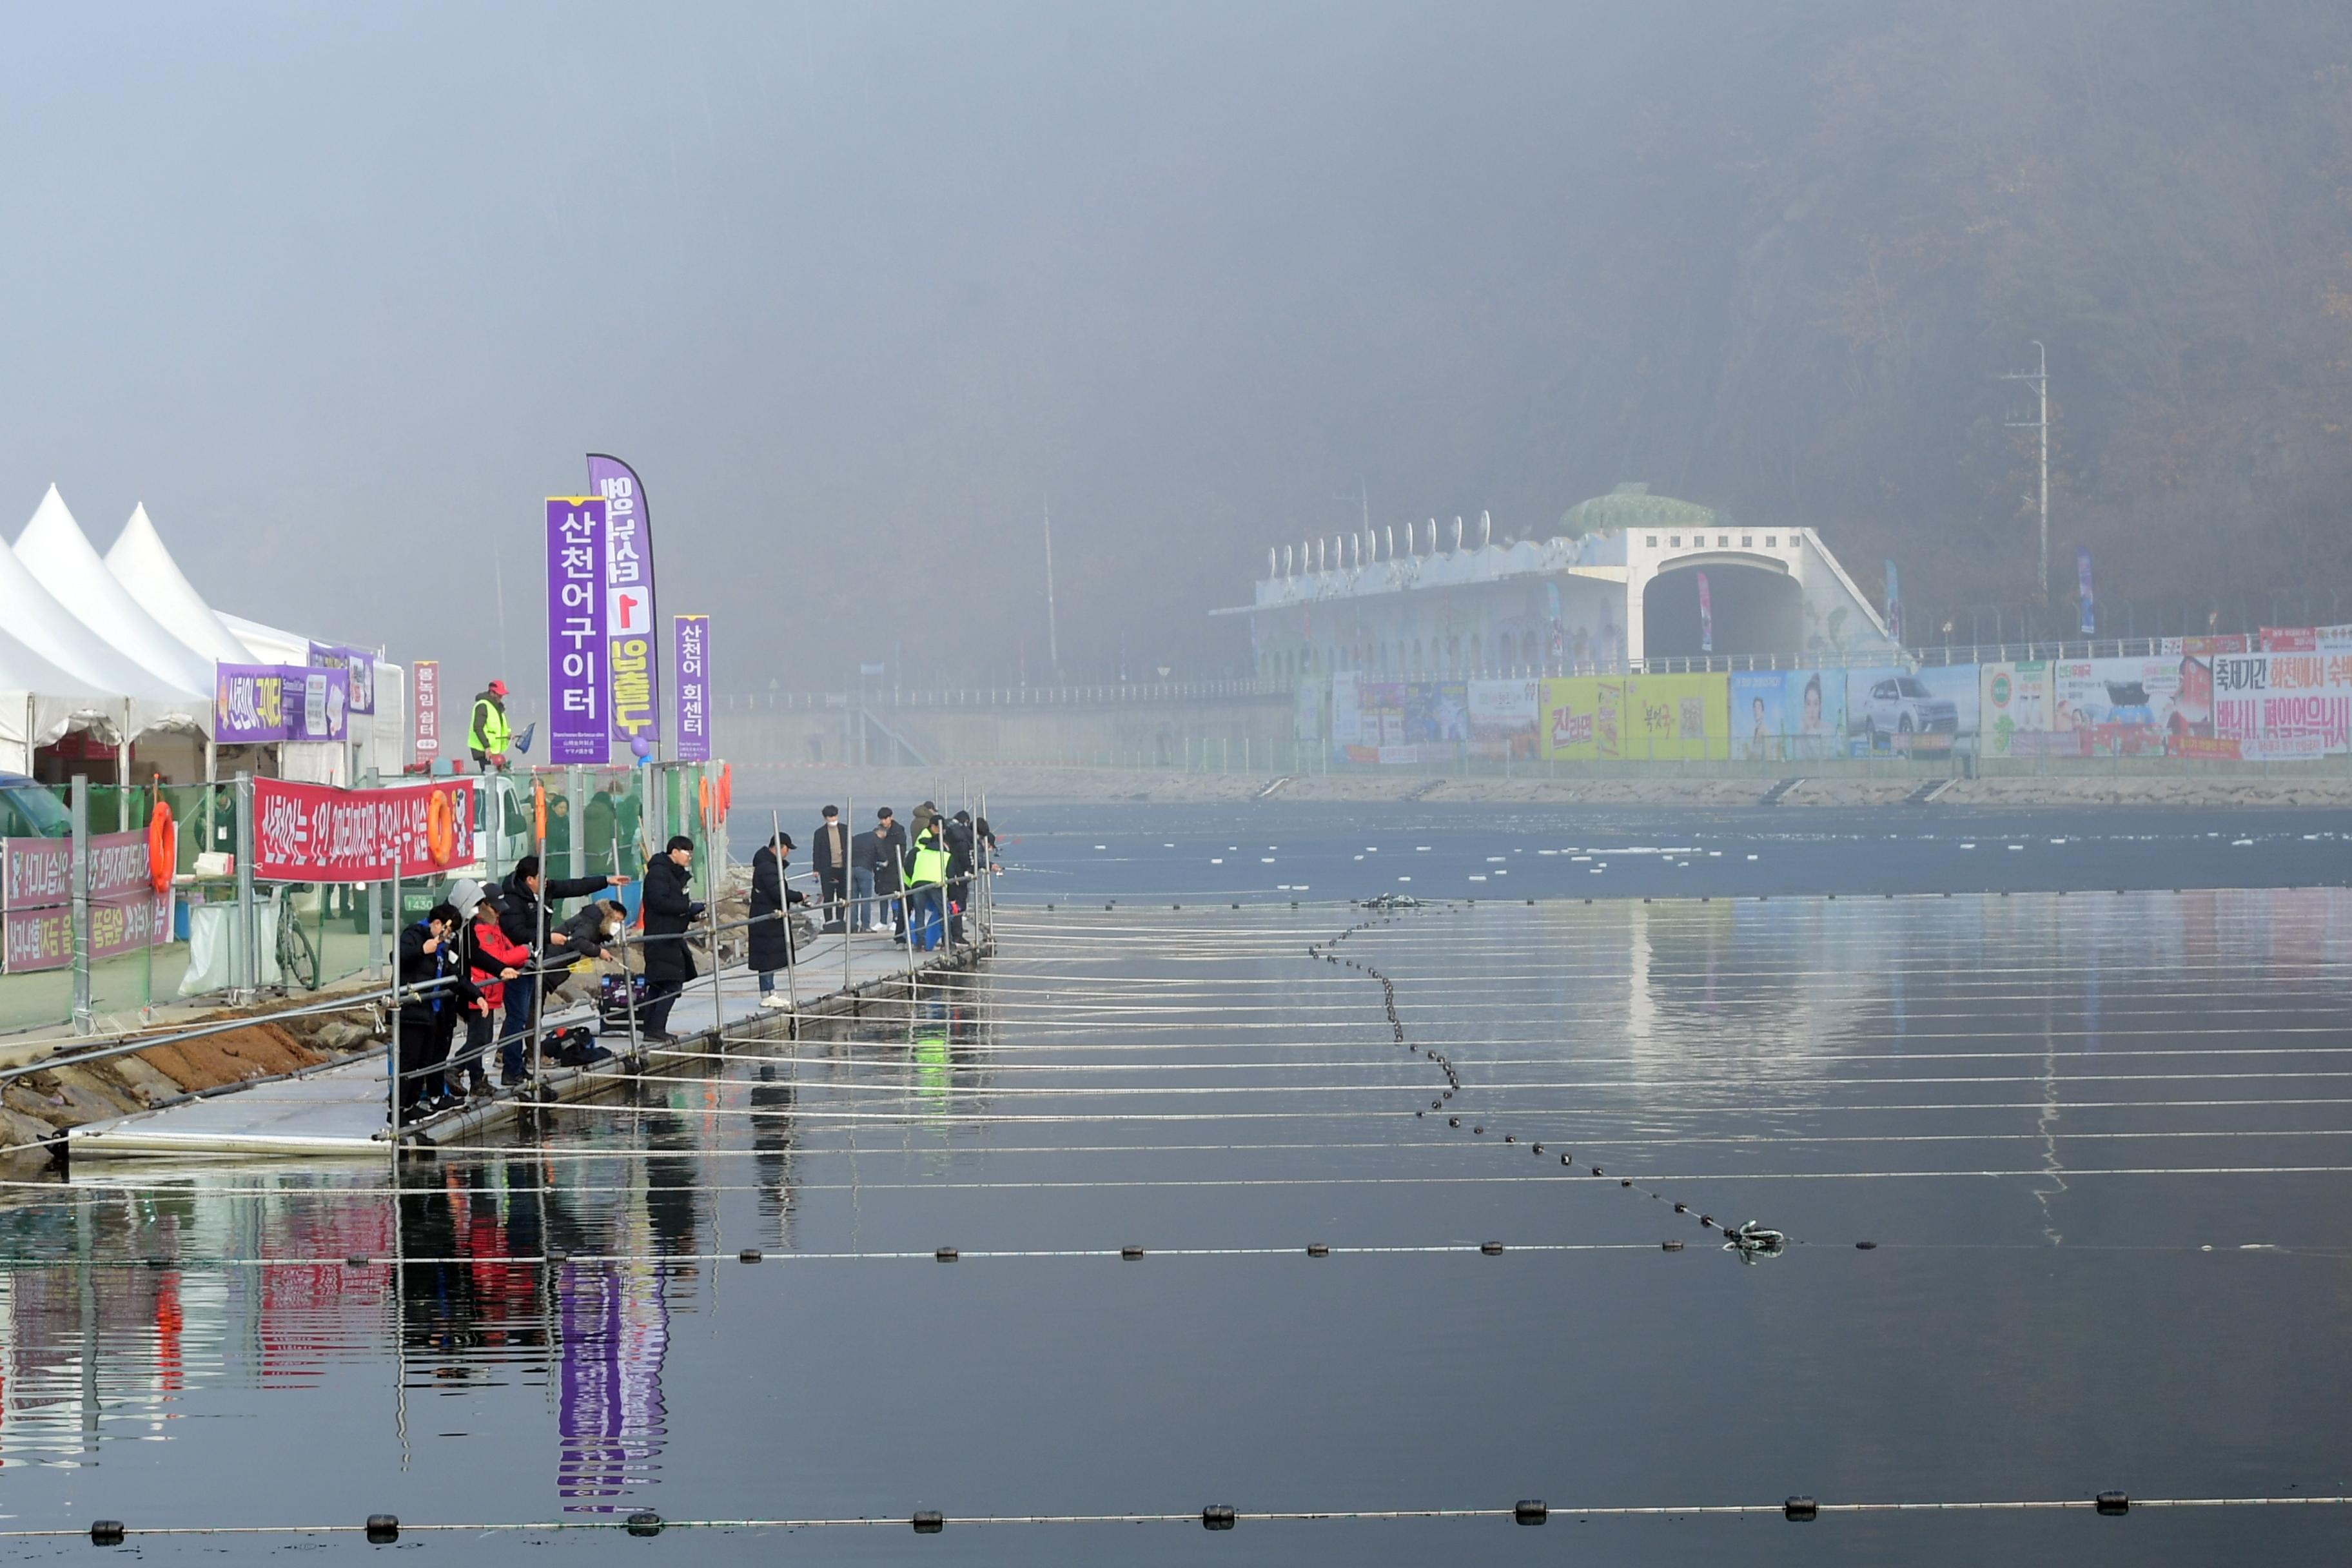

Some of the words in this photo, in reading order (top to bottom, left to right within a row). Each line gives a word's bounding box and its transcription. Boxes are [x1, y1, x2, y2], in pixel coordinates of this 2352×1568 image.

[560, 511, 596, 720] 산천어구이터
[682, 625, 702, 677] 산천어
[2216, 658, 2266, 691] 축제기간
[2269, 656, 2324, 689] 화천에서
[229, 677, 260, 730] 산천어
[418, 668, 434, 707] 몸녹임
[682, 683, 702, 737] 회센터
[420, 711, 434, 737] 쉼터
[1551, 705, 1593, 749] 진라면
[262, 795, 308, 867] 산천어는
[312, 801, 330, 867] 1인
[331, 801, 377, 868] 3마리까지만
[378, 800, 402, 867] 잡으실
[402, 799, 412, 864] 수
[412, 798, 428, 861] 있습
